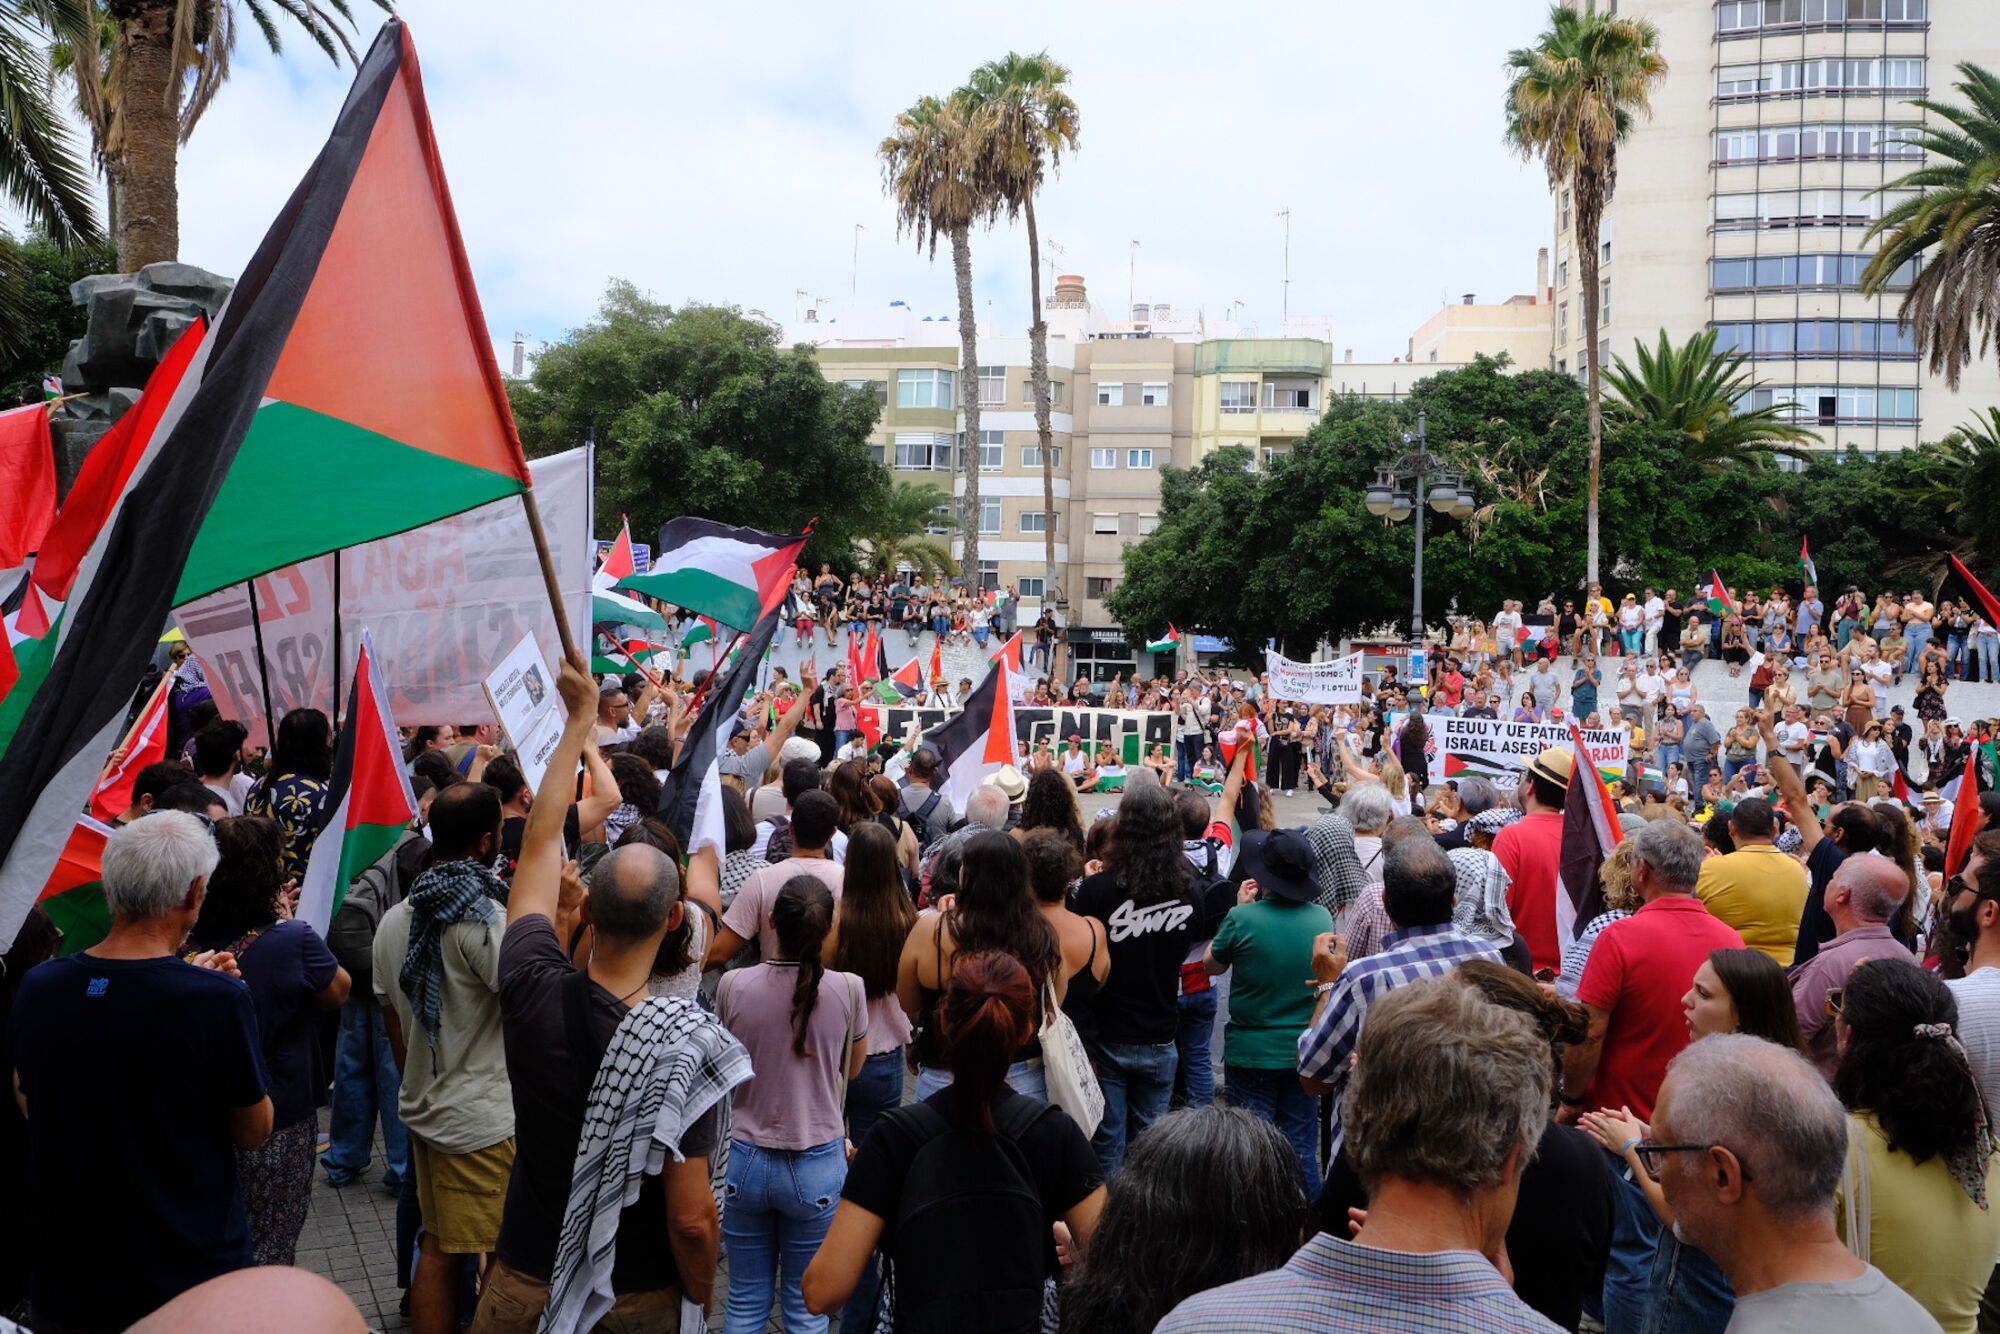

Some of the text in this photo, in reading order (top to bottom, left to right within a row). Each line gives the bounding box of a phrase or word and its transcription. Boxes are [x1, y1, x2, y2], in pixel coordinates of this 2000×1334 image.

[1314, 670, 1343, 678] SOMOS
[1447, 720, 1487, 735] EEUU
[1493, 723, 1502, 736] Y
[1507, 724, 1526, 737] UE
[1445, 737, 1497, 752] ISRAEL
